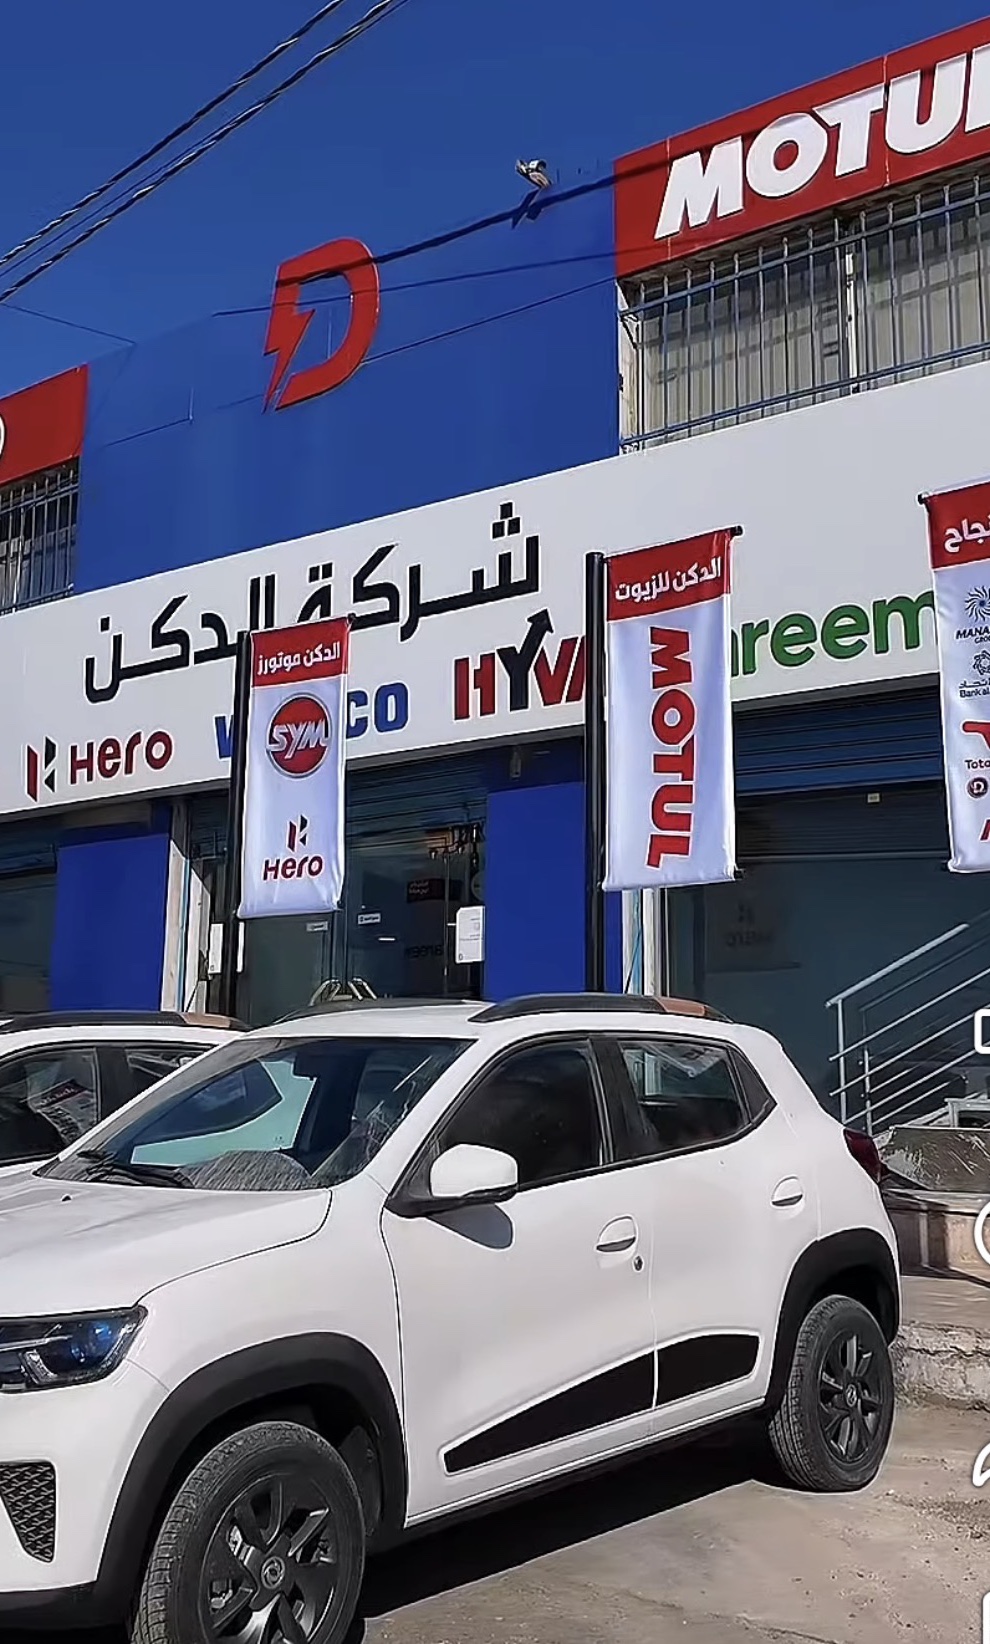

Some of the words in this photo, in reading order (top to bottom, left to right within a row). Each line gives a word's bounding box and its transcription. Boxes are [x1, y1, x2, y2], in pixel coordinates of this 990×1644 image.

[944, 513, 990, 553] جاح
[297, 501, 540, 643] شركة
[615, 570, 670, 603] للزيوت
[672, 556, 721, 592] الدكن
[85, 573, 277, 704] الدكن
[303, 641, 340, 667] الدكن
[257, 651, 301, 675] موتورز
[70, 730, 173, 785] Hero
[267, 719, 330, 759] SYM
[646, 626, 697, 869] MOTUL
[262, 854, 324, 881] Hero
